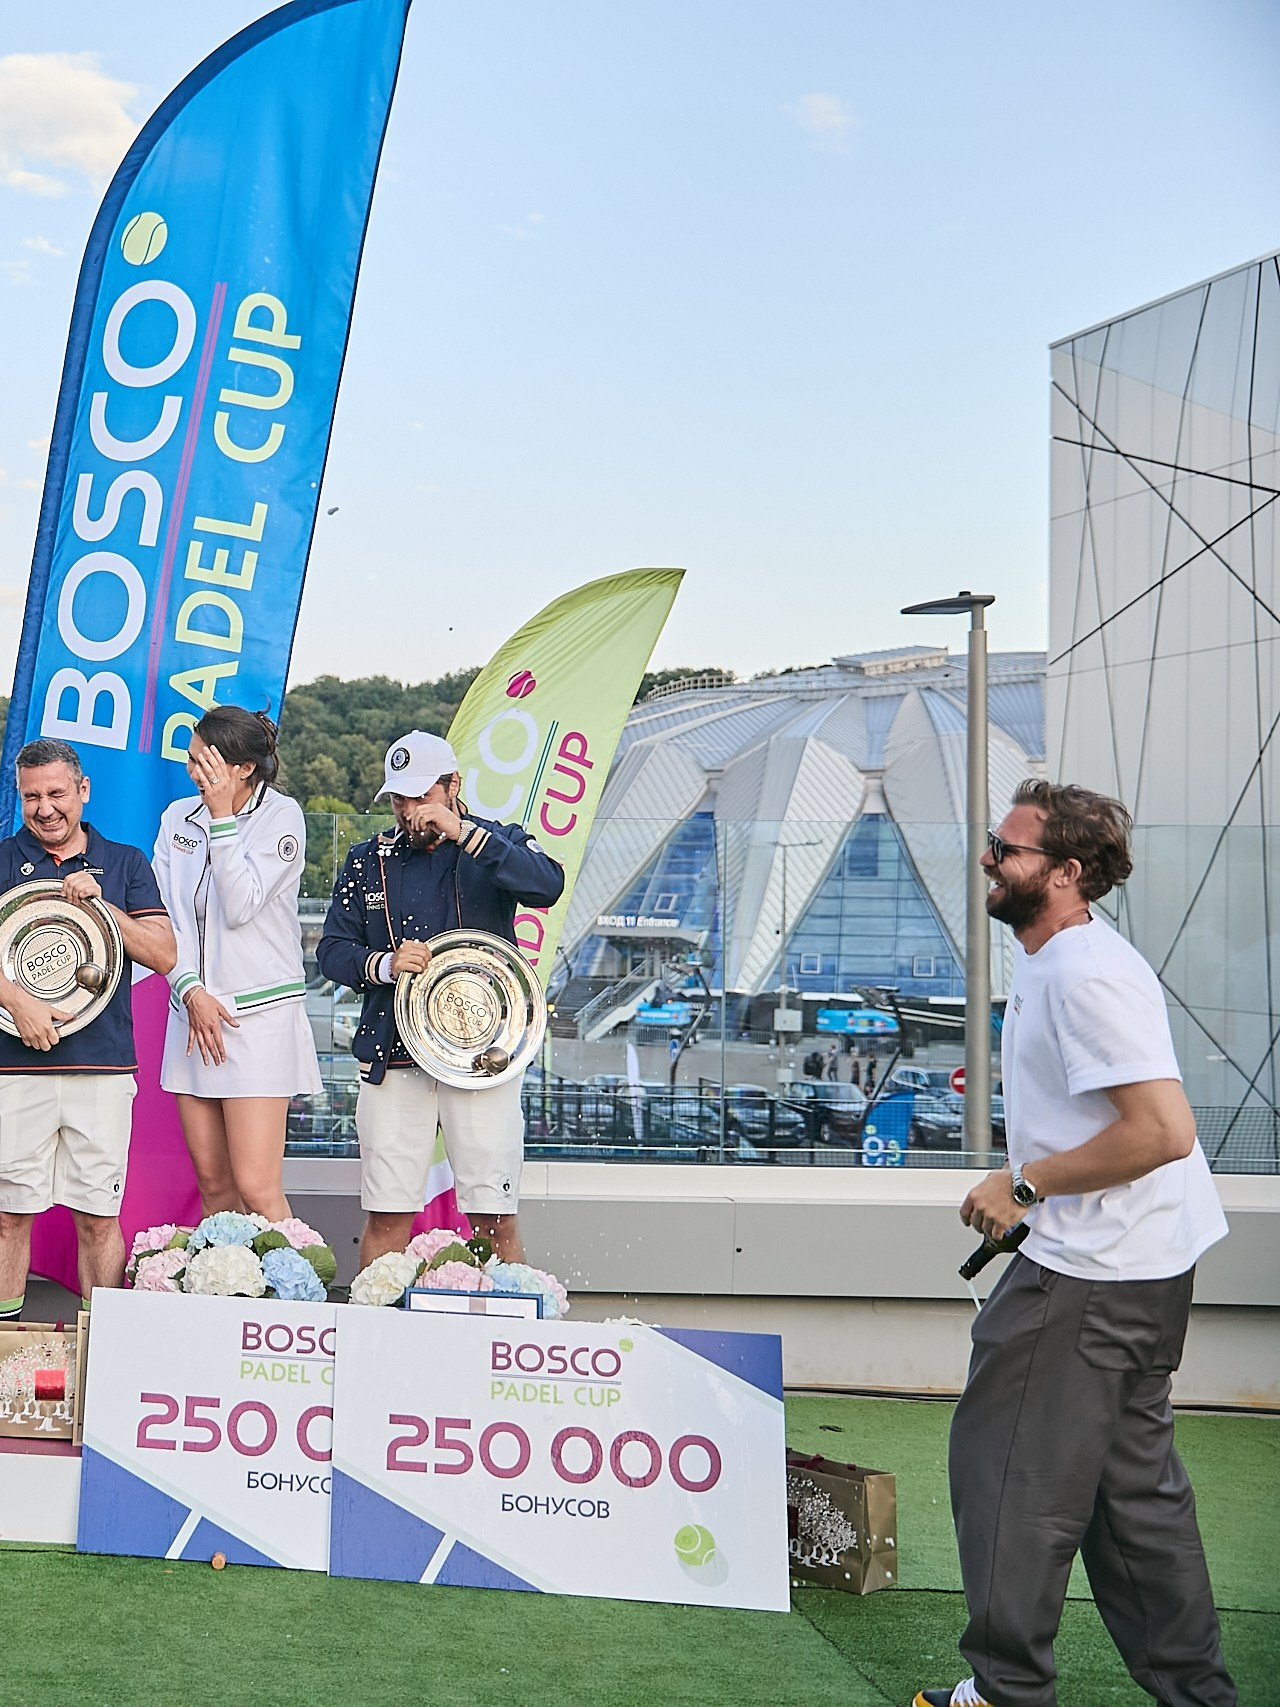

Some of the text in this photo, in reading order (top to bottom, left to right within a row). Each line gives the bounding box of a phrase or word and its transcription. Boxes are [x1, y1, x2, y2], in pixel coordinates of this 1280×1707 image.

[40, 279, 196, 750] BOSCO
[161, 292, 302, 763] PADEL CUP
[540, 731, 594, 836] CUP
[173, 833, 198, 848] BOSCO
[597, 914, 680, 928] ВХОД 11 Entrance
[26, 943, 67, 972] BOSCO
[31, 954, 72, 981] PADEL CUP
[446, 992, 487, 1018] BOSCO
[467, 1016, 483, 1026] CUP
[241, 1321, 336, 1356] BOSC
[240, 1360, 311, 1384] PADEL
[491, 1341, 621, 1377] BOSCO
[490, 1381, 621, 1408] PADEL CUP
[136, 1392, 278, 1456] 250
[386, 1413, 531, 1479] 250
[551, 1426, 722, 1492] 000
[247, 1471, 332, 1495] БОНУСО
[501, 1493, 610, 1518] БОНУСОВ
